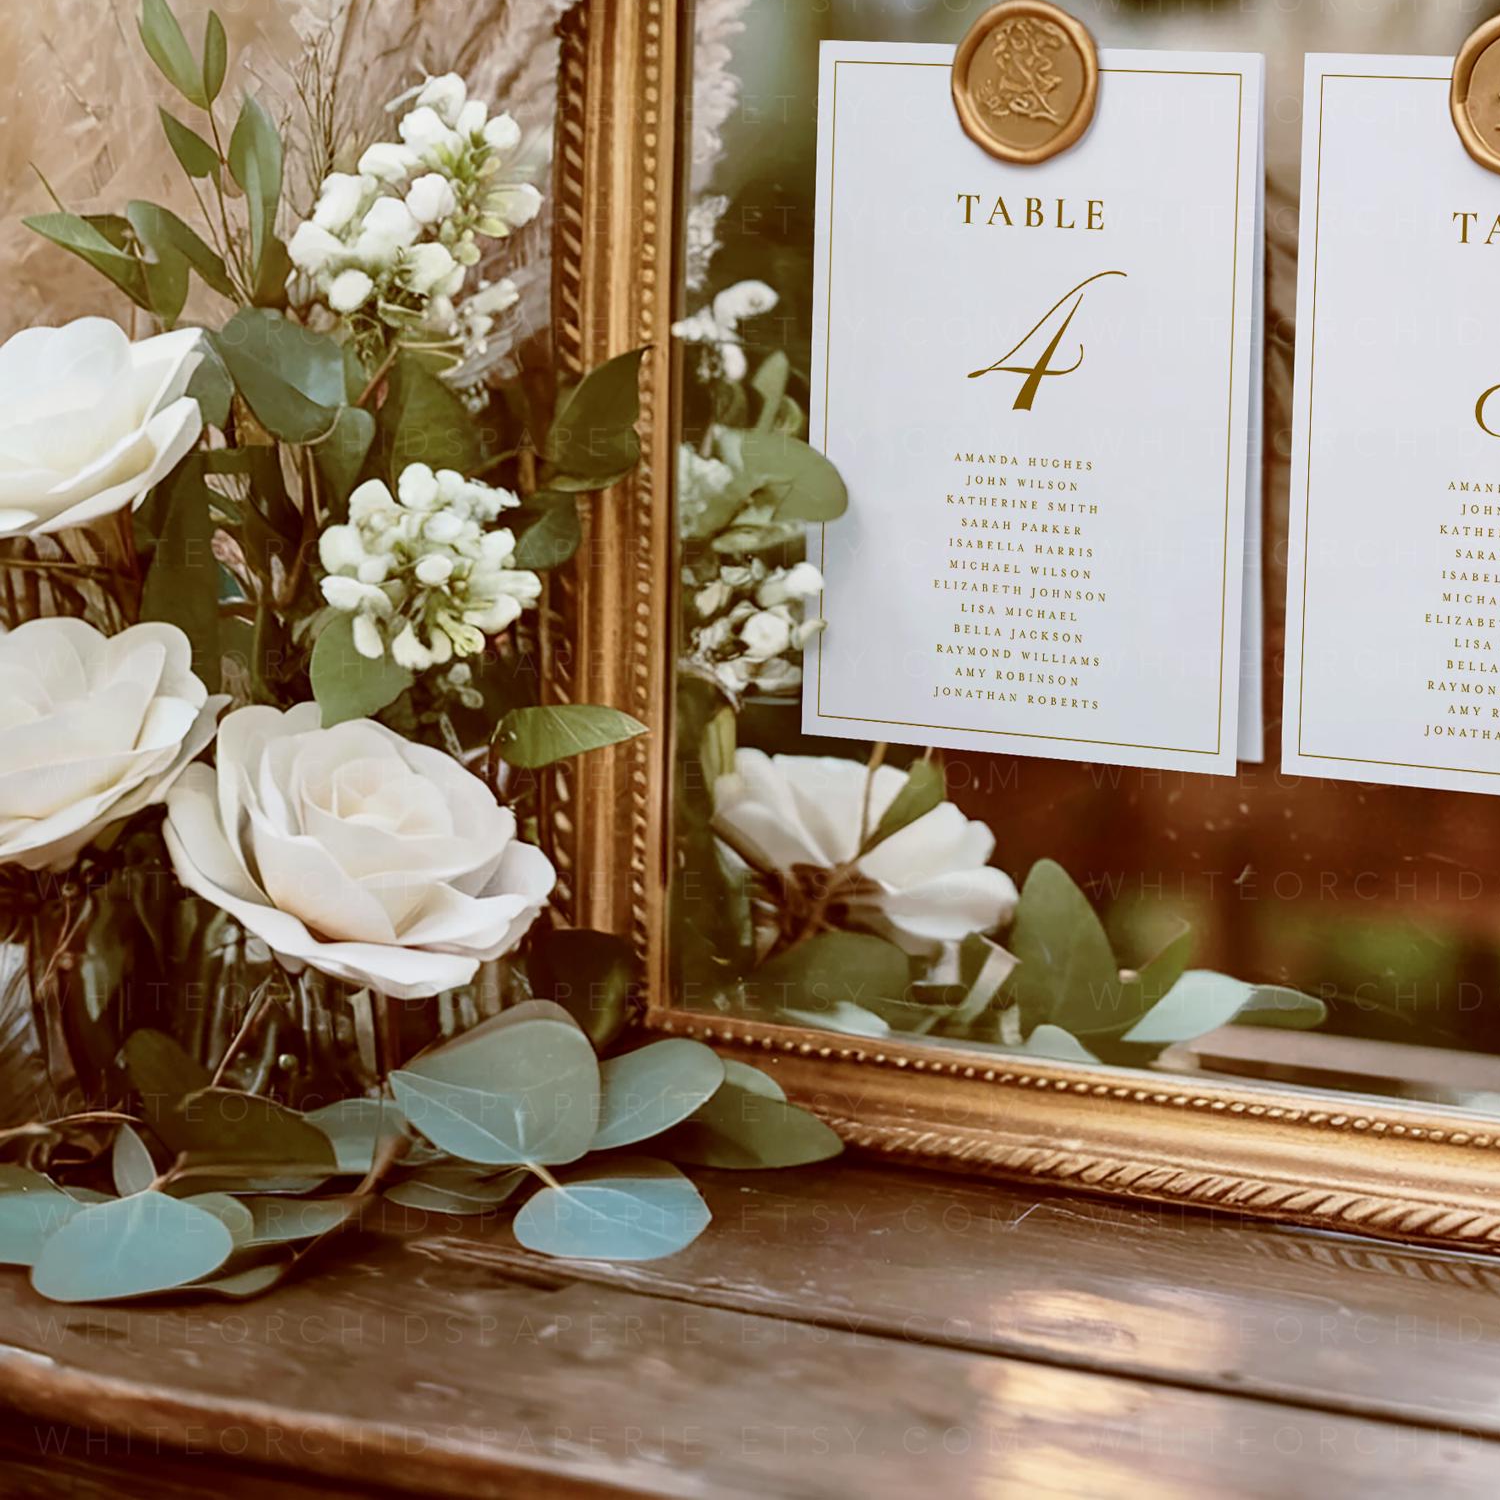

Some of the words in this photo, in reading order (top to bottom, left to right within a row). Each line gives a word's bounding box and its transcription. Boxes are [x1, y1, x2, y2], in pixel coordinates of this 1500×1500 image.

[957, 193, 1104, 230] TABLE
[967, 271, 1127, 411] 4
[954, 452, 1018, 466] AMANDA
[1028, 457, 1092, 471] HUGHES
[965, 475, 1007, 486] JOHN
[1017, 478, 1077, 491] WILSON
[946, 494, 1038, 510] KATHERINE
[1047, 501, 1098, 515] SMITH
[961, 517, 1011, 530] SARAH
[1021, 522, 1081, 536] PARKER
[949, 537, 1024, 553] ISABELLA
[1035, 544, 1093, 558] HARRIS
[949, 559, 1021, 574] MICHAEL
[1030, 566, 1091, 580] WILSON
[934, 579, 1021, 596] ELIZABETH
[1030, 587, 1106, 602] JOHNSON
[954, 623, 1001, 637] BELLA
[1009, 628, 1082, 643] JACKSON
[936, 643, 1012, 659] RAYMOND
[1021, 651, 1099, 667] WILLIAMS
[1454, 638, 1491, 651] LISA
[1446, 659, 1498, 673] BELLA
[933, 686, 1017, 702] JONATHAN
[1027, 694, 1098, 710] ROBERTS
[1448, 705, 1481, 716] AMY
